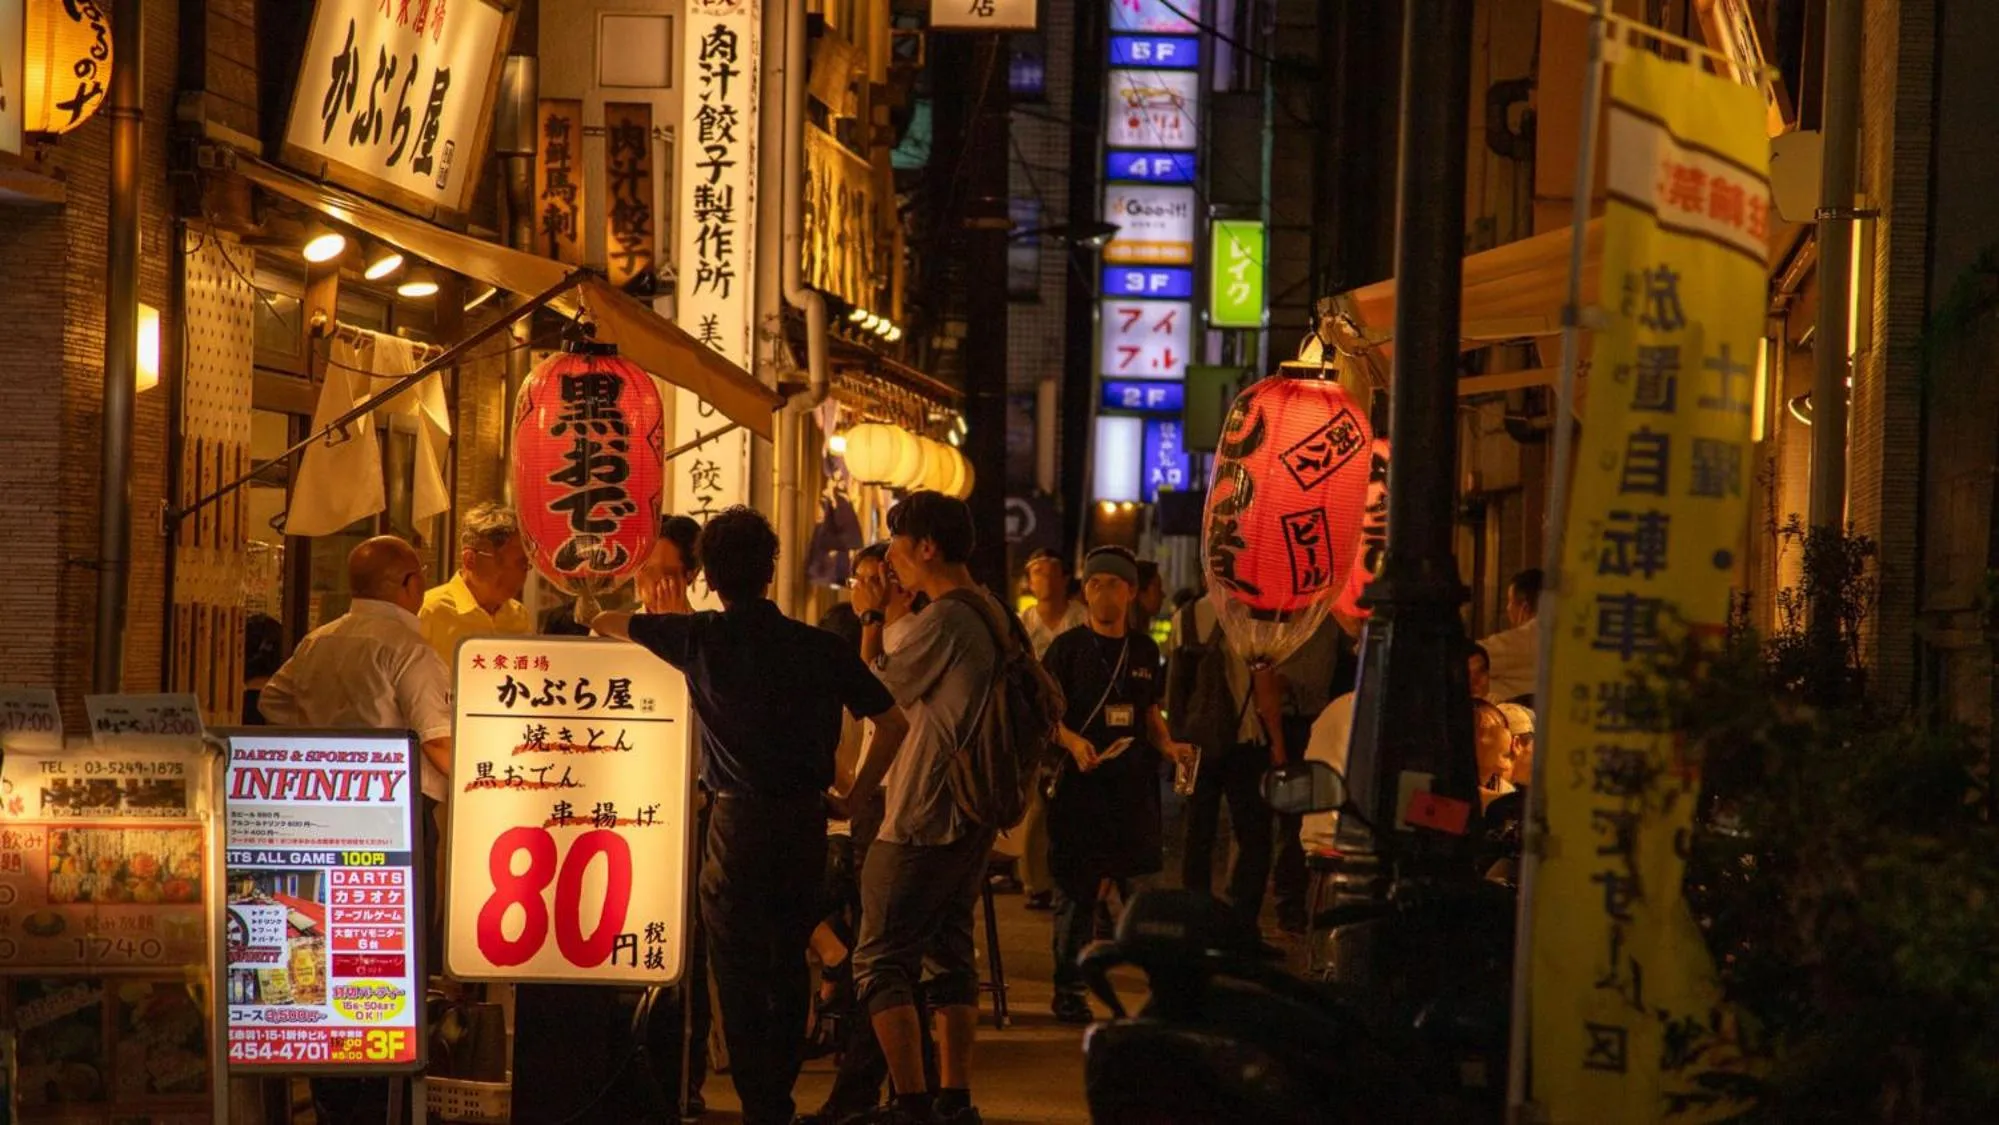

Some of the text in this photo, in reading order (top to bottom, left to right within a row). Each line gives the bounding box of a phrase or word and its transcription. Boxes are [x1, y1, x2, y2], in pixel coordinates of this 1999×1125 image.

[321, 16, 451, 177] かぶら屋
[693, 23, 741, 301] 肉汁餃子製作所
[1129, 158, 1173, 177] 4F
[608, 118, 654, 276] 肉汁餃子
[1126, 273, 1169, 293] 3F
[1227, 240, 1253, 306] レイク
[1122, 388, 1166, 408] 2F
[548, 374, 638, 574] 黒おでん
[1291, 513, 1328, 589] ビール
[472, 654, 550, 672] 大衆酒場
[497, 675, 634, 712] かぶら屋
[522, 725, 634, 753] 焼きとん
[39, 761, 66, 774] TEL
[84, 760, 184, 774] 03-5249-1875
[233, 749, 406, 764] DARTS & SPORTS BAR
[229, 767, 407, 802] INFINITY
[475, 762, 580, 789] 黒おでん
[550, 799, 661, 829] 串揚げ
[257, 851, 286, 864] ALL
[290, 852, 334, 865] GAME
[342, 851, 386, 866] 100円
[333, 872, 403, 884] DARTS
[335, 889, 401, 903] カラオケ
[334, 911, 402, 921] テーブルゲーム
[645, 923, 667, 971] 税抜
[231, 1009, 264, 1021] コース
[229, 1042, 329, 1060] 454-4701
[366, 1029, 406, 1060] 3F
